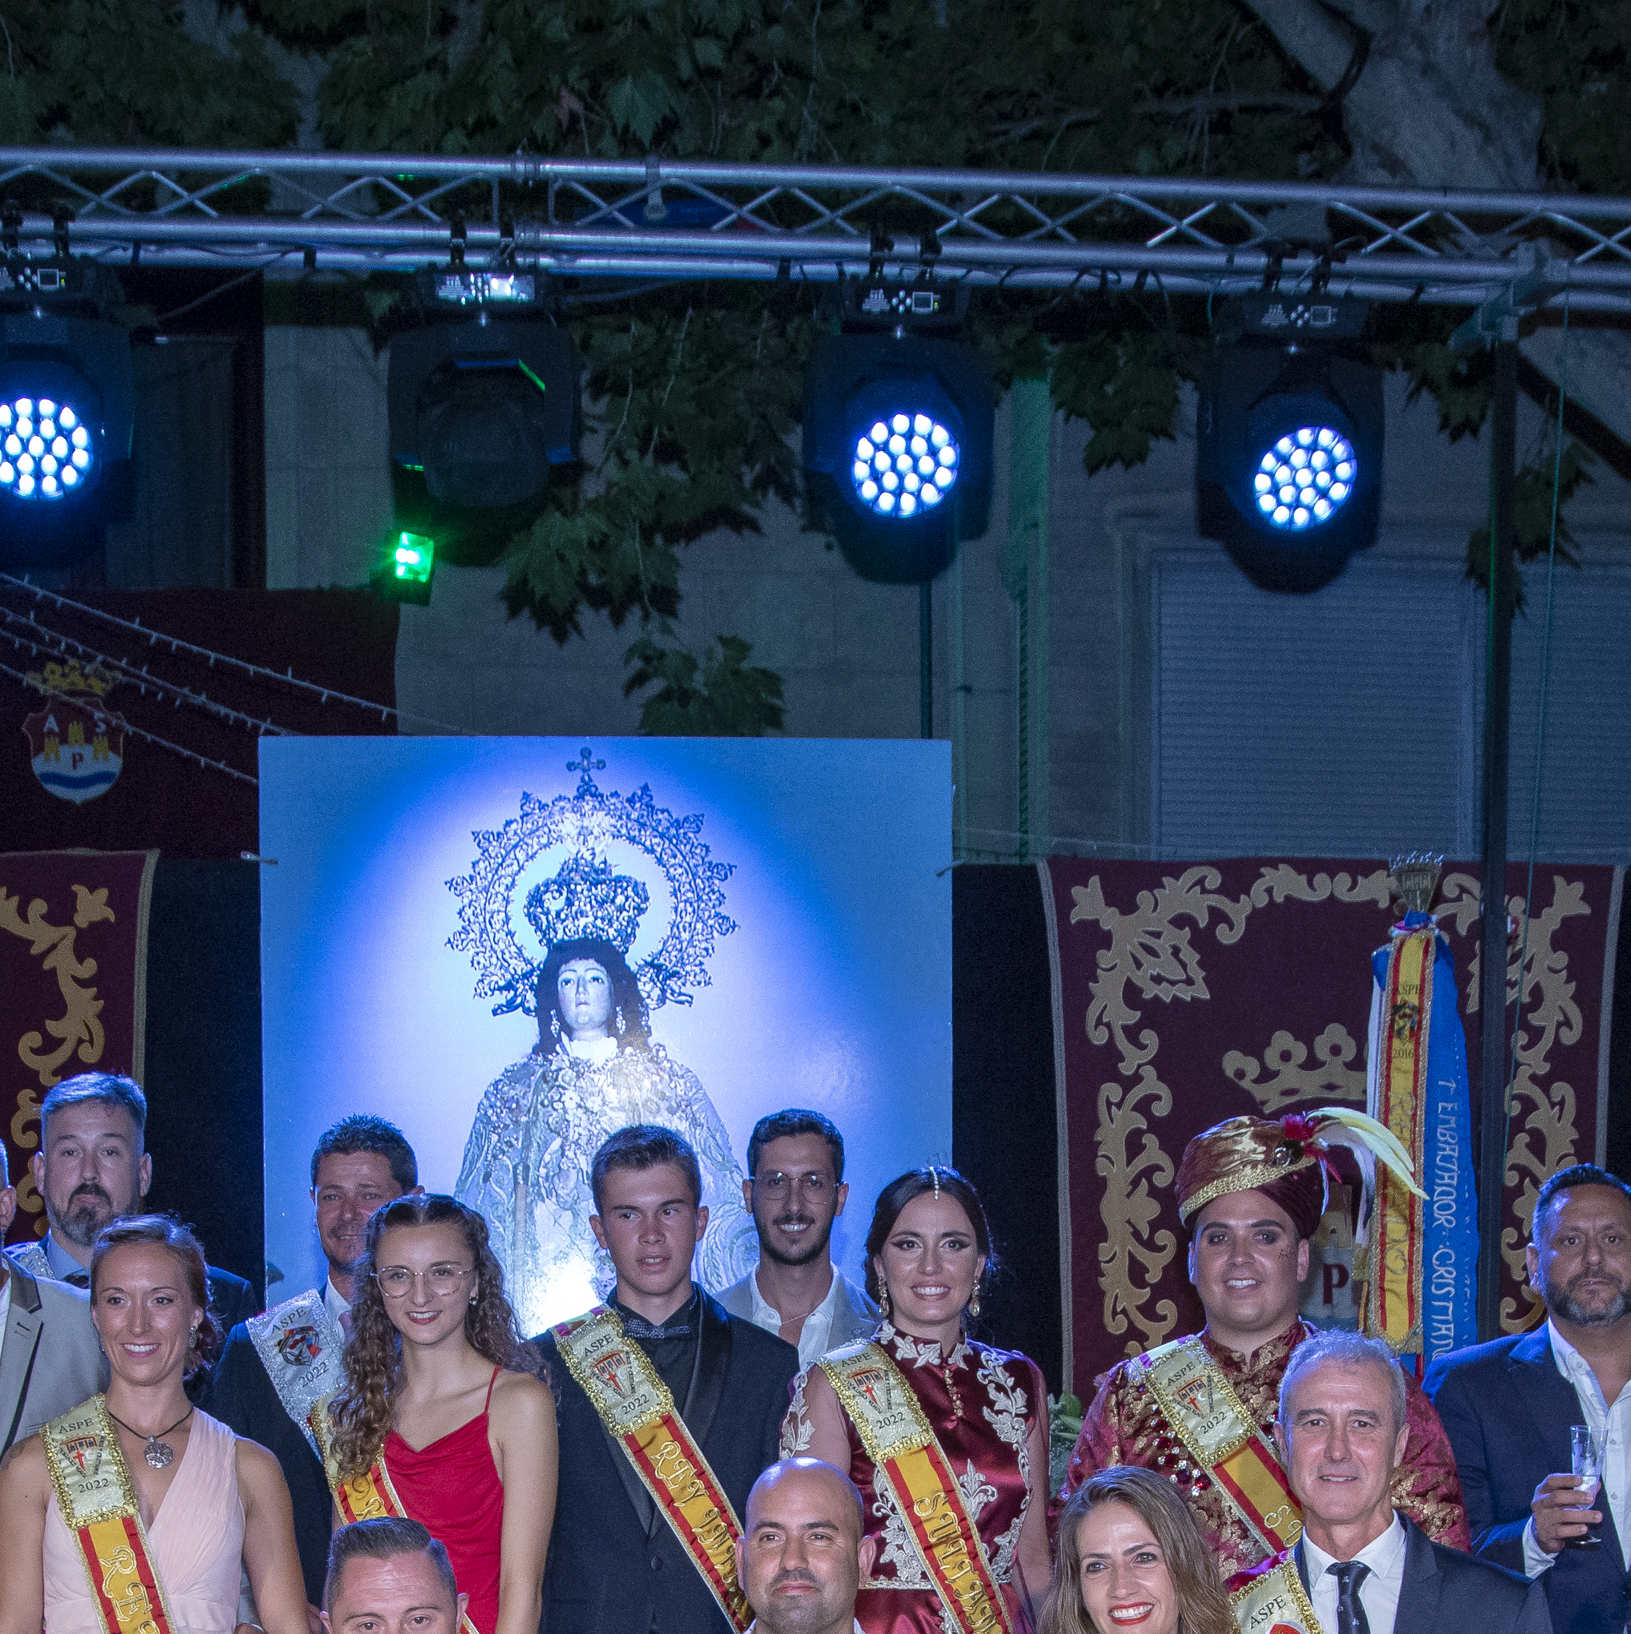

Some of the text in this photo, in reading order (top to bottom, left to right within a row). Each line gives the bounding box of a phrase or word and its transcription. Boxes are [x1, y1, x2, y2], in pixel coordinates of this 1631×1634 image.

[1432, 1101, 1460, 1229] EMBAJADOR
[1323, 1263, 1349, 1305] P
[271, 1308, 307, 1334] ASPE
[583, 1333, 615, 1357] ASPE
[841, 1352, 873, 1368] ASPE
[299, 1361, 330, 1388] 2022
[1167, 1362, 1196, 1386] ASPE
[621, 1393, 650, 1416] 2022
[58, 1418, 94, 1435] ASPE
[876, 1412, 906, 1429] 2022
[1200, 1411, 1227, 1435] 2022
[78, 1478, 110, 1494] 2022
[1248, 1594, 1288, 1630] ASPE
